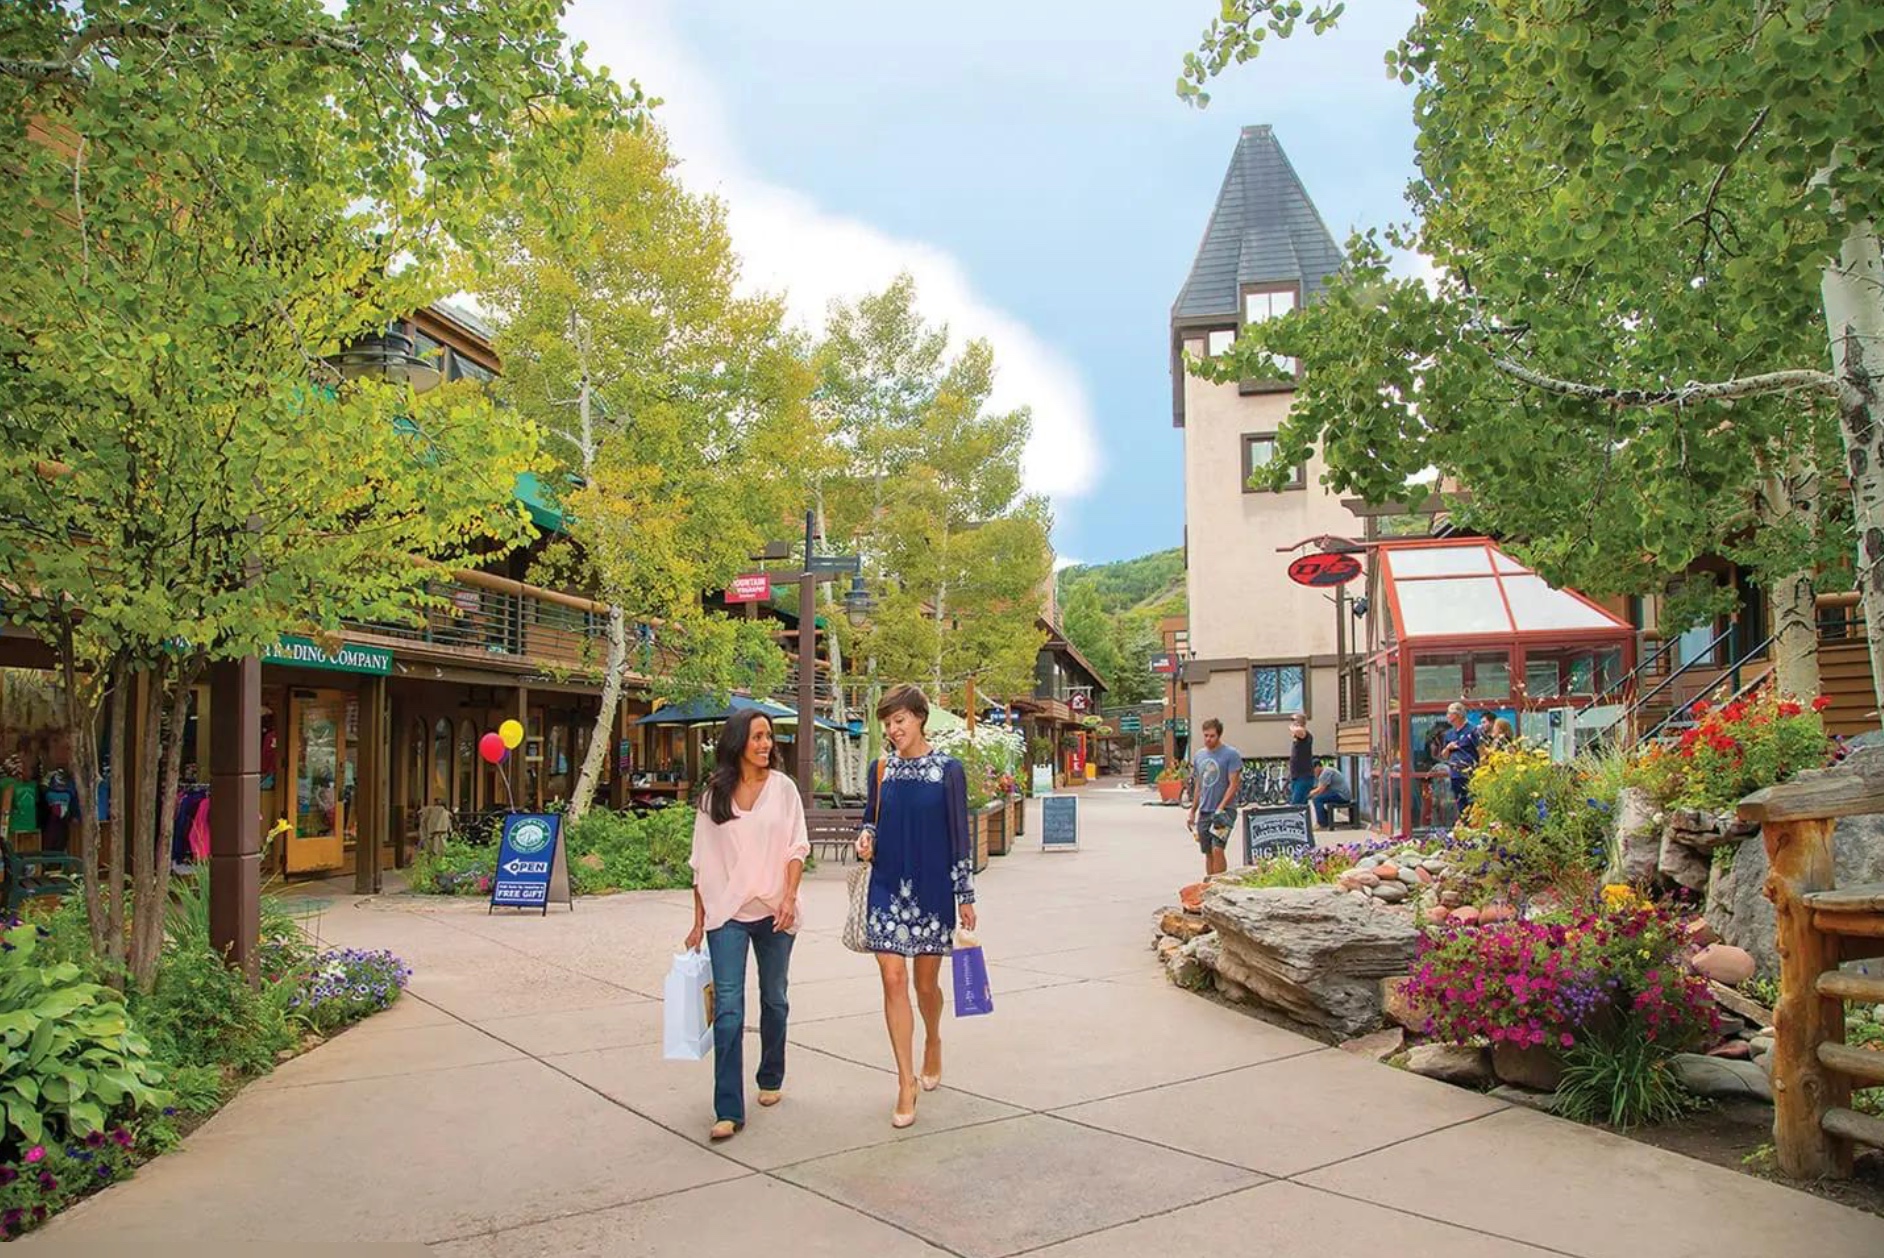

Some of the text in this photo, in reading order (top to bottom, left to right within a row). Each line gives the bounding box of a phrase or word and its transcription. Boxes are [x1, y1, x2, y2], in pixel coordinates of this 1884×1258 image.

[265, 643, 389, 669] TRADING COMPANY
[1252, 847, 1273, 860] BIG
[510, 862, 545, 872] OPEN
[498, 890, 543, 898] FREE GIFT
